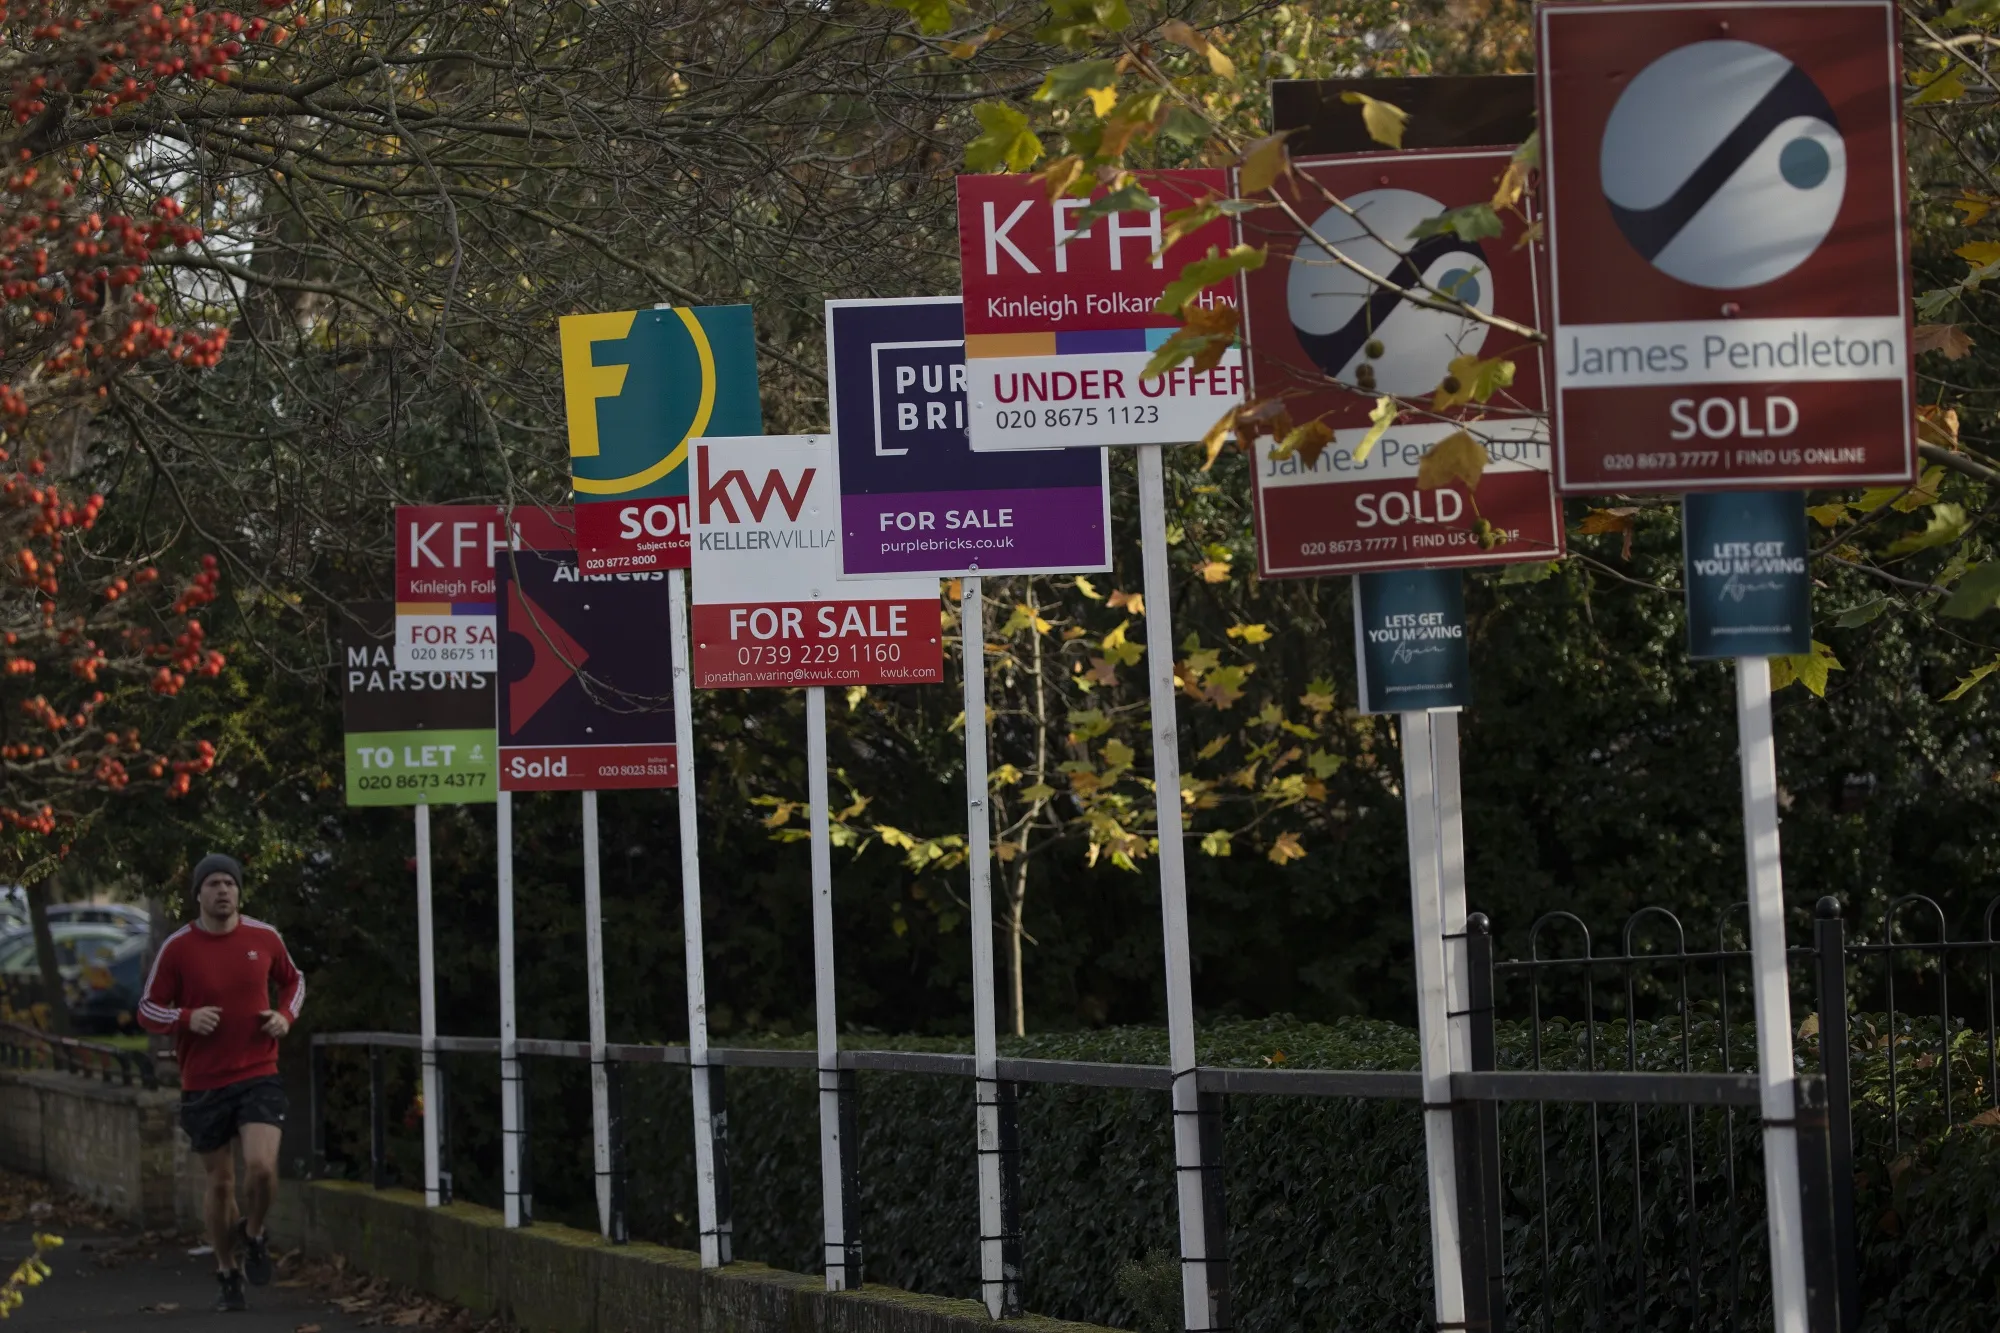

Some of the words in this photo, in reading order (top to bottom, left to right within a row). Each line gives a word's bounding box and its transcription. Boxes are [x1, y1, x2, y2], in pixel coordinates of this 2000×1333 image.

[983, 196, 1163, 275] KFH
[988, 294, 1077, 321] Kinleigh
[1567, 337, 1688, 376] James
[1704, 332, 1895, 370] Pendleton
[896, 364, 967, 394] PUR
[993, 369, 1125, 403] UNDER
[898, 401, 963, 431] BRI
[996, 410, 1036, 429] 020
[1044, 408, 1098, 427] 8675
[1107, 406, 1159, 425] 1123
[1669, 396, 1799, 440] SOLD
[1381, 438, 1540, 468] Peton
[1603, 454, 1633, 470] 020
[1636, 453, 1676, 469] 8673
[1681, 451, 1719, 467] 7777
[1736, 449, 1774, 466] FIND
[1778, 448, 1801, 465] US
[1804, 447, 1865, 464] ONLINE
[697, 446, 816, 524] kw
[880, 511, 935, 531] FOR
[945, 508, 1014, 529] SALE
[1354, 488, 1463, 528] SOLD
[620, 503, 690, 539] SOL
[410, 522, 521, 568] KFH
[637, 542, 667, 551] Subject
[668, 540, 677, 548] to
[679, 540, 691, 548] Co
[881, 536, 1014, 555] purplebricks.co.uk
[1301, 543, 1326, 555] 020
[1329, 540, 1362, 553] 8673
[1365, 537, 1397, 550] 7777
[1412, 534, 1445, 547] FIND
[1448, 532, 1466, 545] US
[1713, 542, 1751, 558] LETS
[1752, 542, 1784, 557] GET
[586, 559, 604, 569] 020
[607, 557, 630, 567] 8772
[632, 555, 657, 565] 8000
[1693, 559, 1731, 576] YOU
[553, 566, 664, 582] Anews
[410, 580, 466, 597] Kinleigh
[730, 607, 804, 641] FOR
[816, 605, 908, 638] SALE
[1385, 614, 1416, 628] LETS
[1418, 612, 1444, 626] GET
[412, 626, 456, 644] FOR
[466, 626, 496, 644] SA
[1368, 629, 1399, 643] YOU
[412, 648, 436, 660] 020
[441, 647, 474, 660] 8675
[481, 648, 494, 659] 11
[738, 646, 791, 665] 0739
[800, 645, 839, 664] 229
[850, 643, 901, 663] 1160
[349, 671, 487, 693] PARSONS
[704, 669, 860, 685] jonathan.waring@kwuk.com
[880, 667, 936, 678] kwuk.com
[357, 747, 394, 769] TO
[404, 744, 456, 768] LET
[511, 756, 567, 778] Sold
[358, 776, 391, 790] 020
[396, 774, 440, 789] 8673
[444, 773, 487, 787] 4377
[599, 766, 619, 776] 020
[621, 765, 646, 776] 8023
[647, 764, 668, 775] 5131
